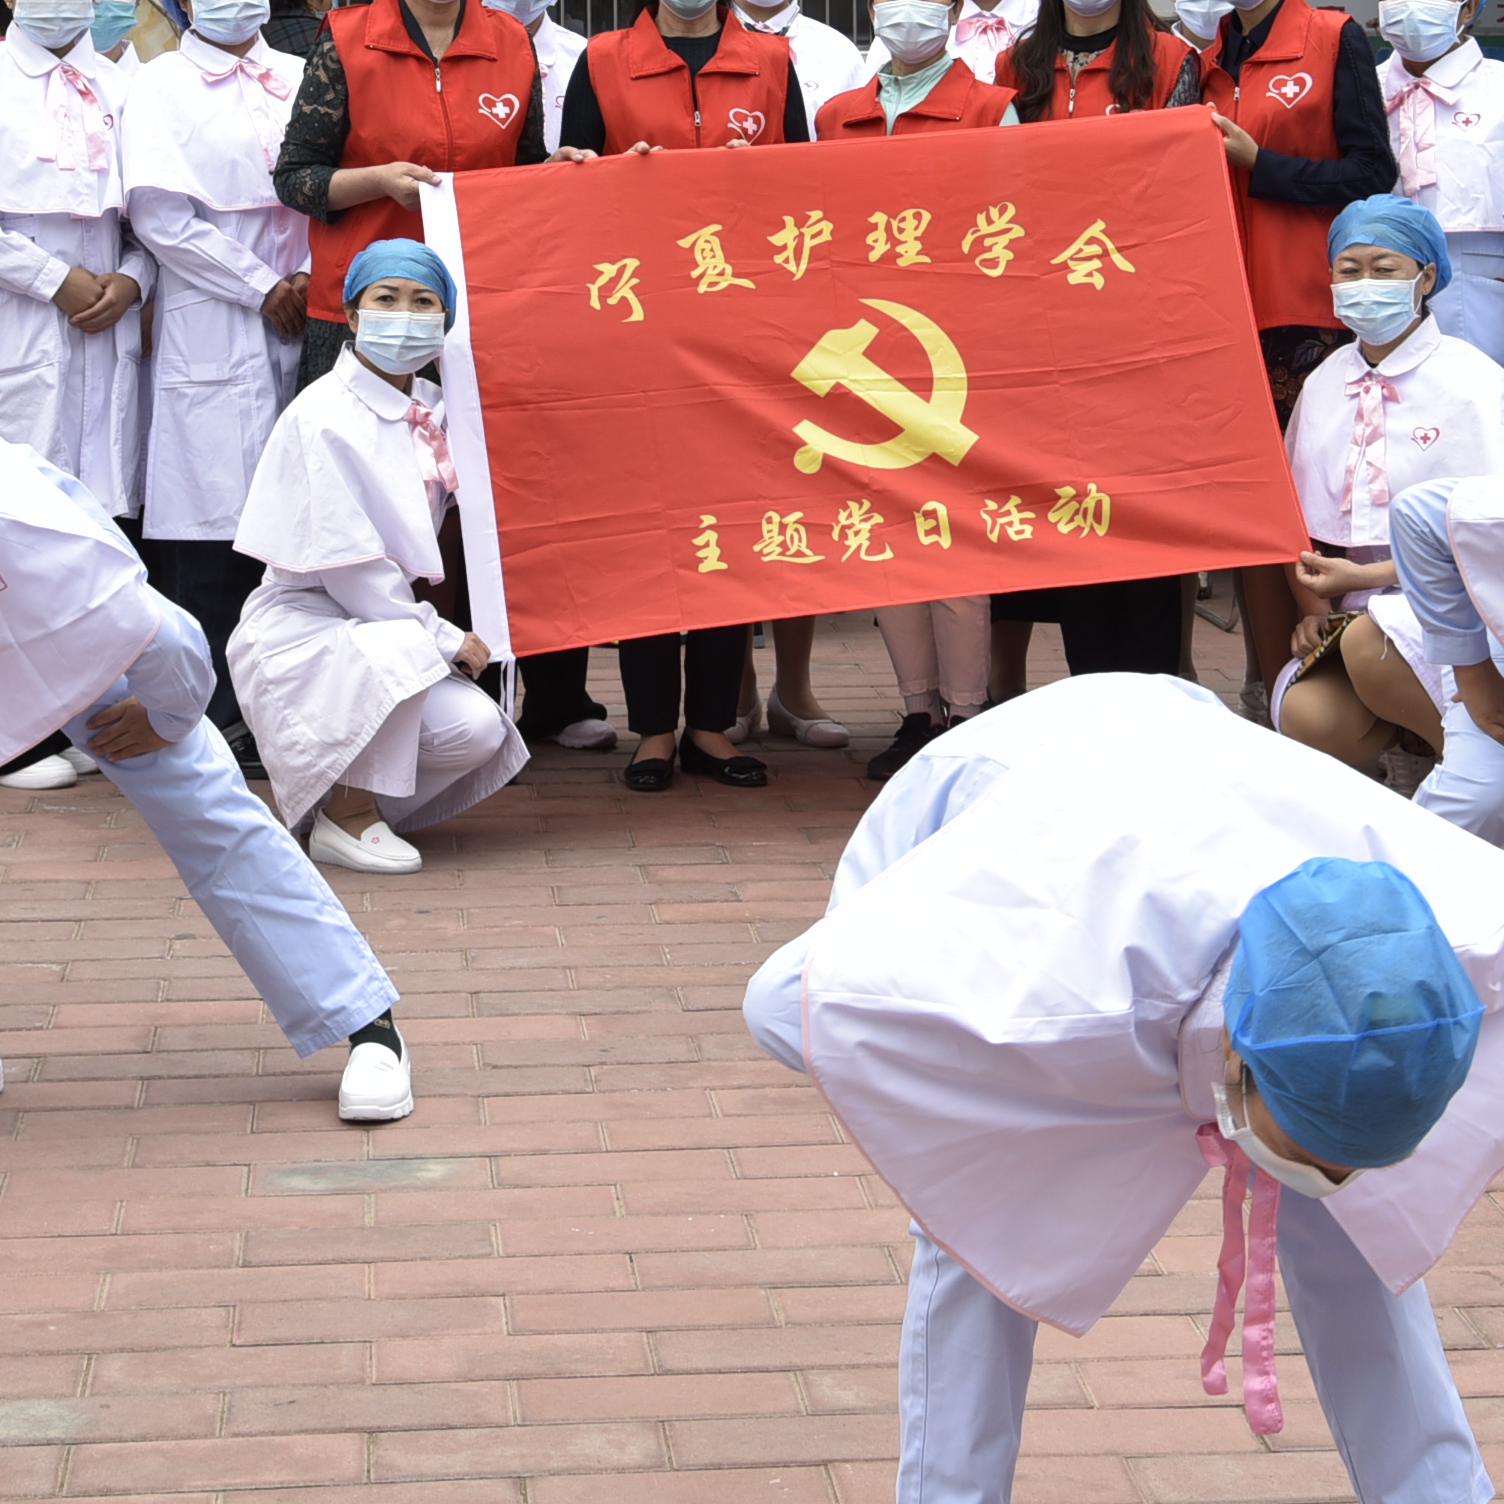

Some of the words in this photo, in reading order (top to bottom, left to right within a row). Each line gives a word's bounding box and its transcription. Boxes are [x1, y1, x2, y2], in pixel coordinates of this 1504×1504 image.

[586, 201, 1136, 323] 宁夏护理学会
[692, 482, 1111, 573] 主题党日活动
